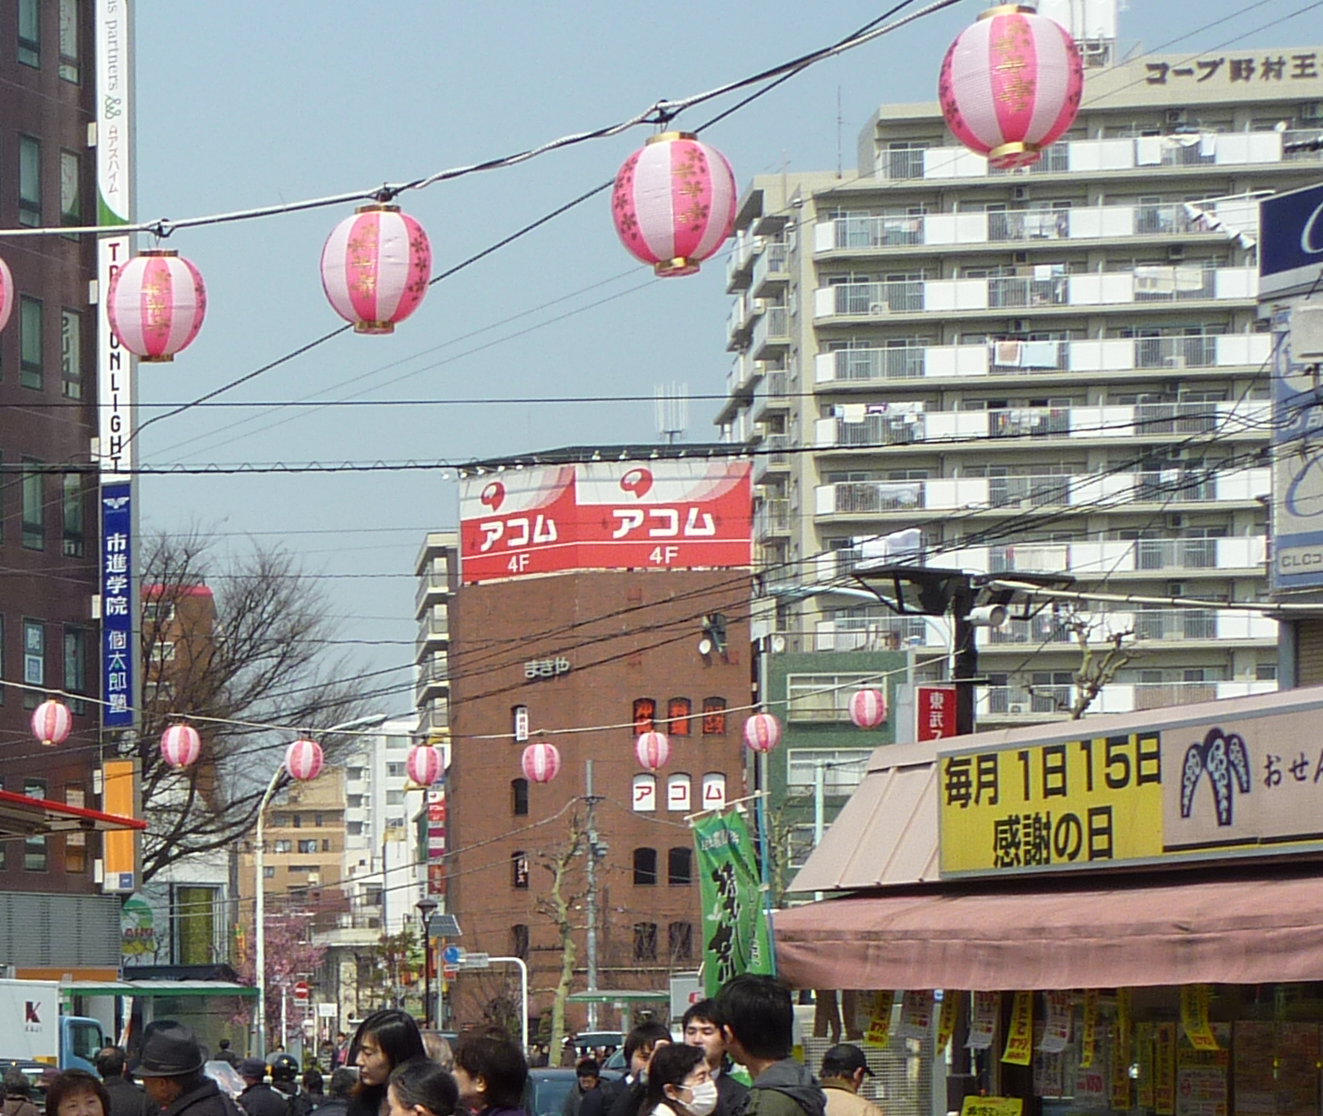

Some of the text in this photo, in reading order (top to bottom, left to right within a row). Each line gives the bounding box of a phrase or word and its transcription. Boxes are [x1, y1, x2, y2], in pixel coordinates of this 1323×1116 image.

[105, 19, 119, 91] partners
[1145, 54, 1323, 85] コープ野村王
[480, 514, 558, 552] アコム
[612, 507, 716, 539] アコム
[508, 554, 530, 573] 4F
[649, 546, 679, 564] 4F
[106, 533, 128, 616] 市進学院
[108, 630, 128, 714] 個太郎塾
[524, 656, 570, 679] まきや
[635, 785, 722, 801] アコム
[993, 806, 1113, 868] 感謝の日
